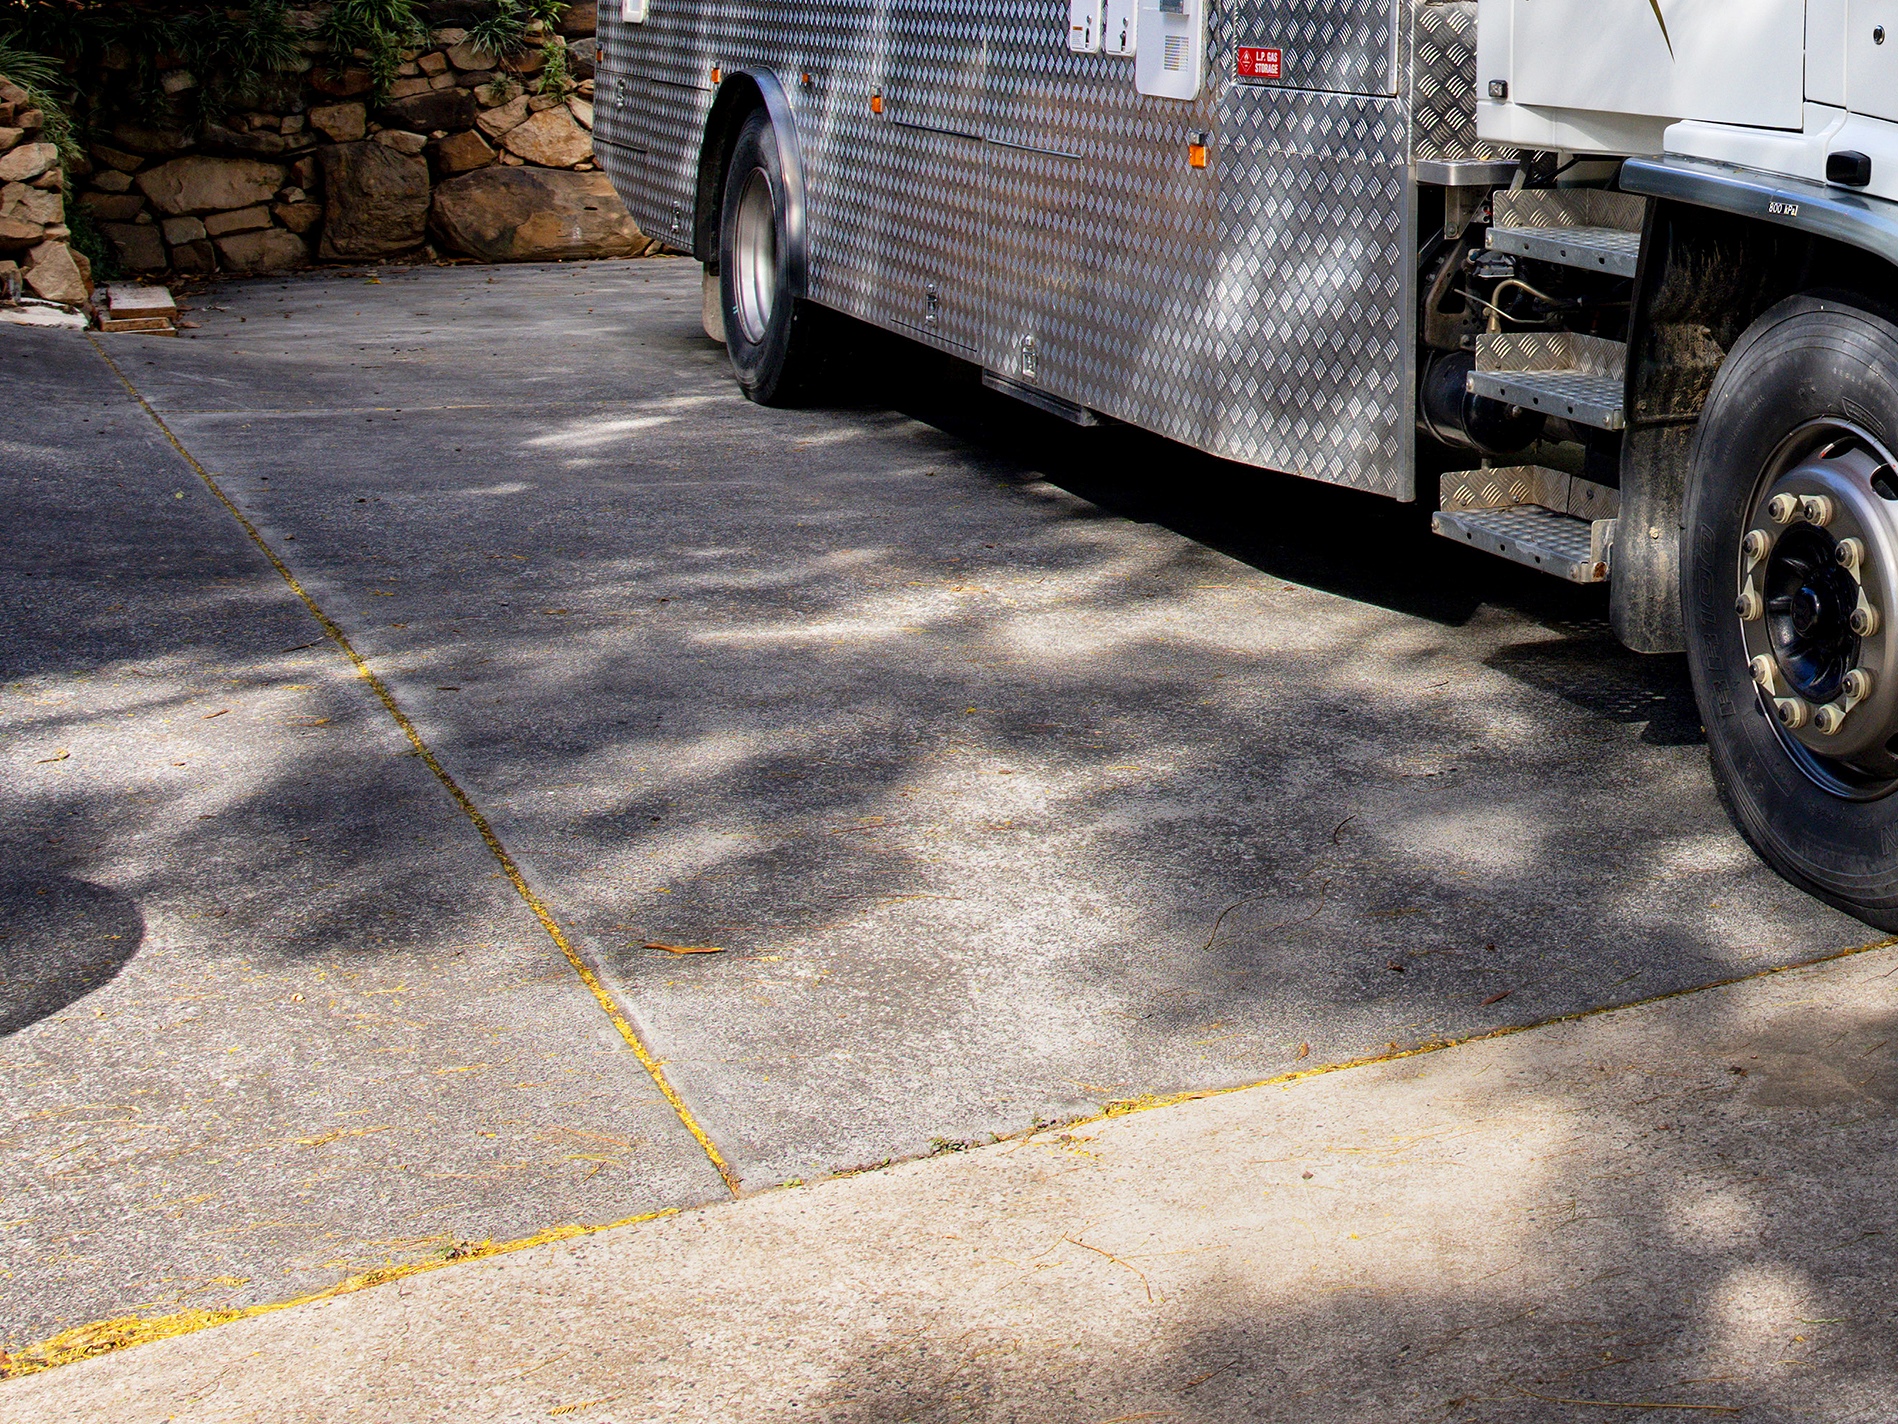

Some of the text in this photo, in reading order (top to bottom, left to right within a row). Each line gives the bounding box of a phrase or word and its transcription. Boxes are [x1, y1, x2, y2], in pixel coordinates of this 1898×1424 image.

[1256, 51, 1278, 63] L.P. GAS
[1255, 63, 1279, 75] STORAGE
[1768, 202, 1782, 214] 800
